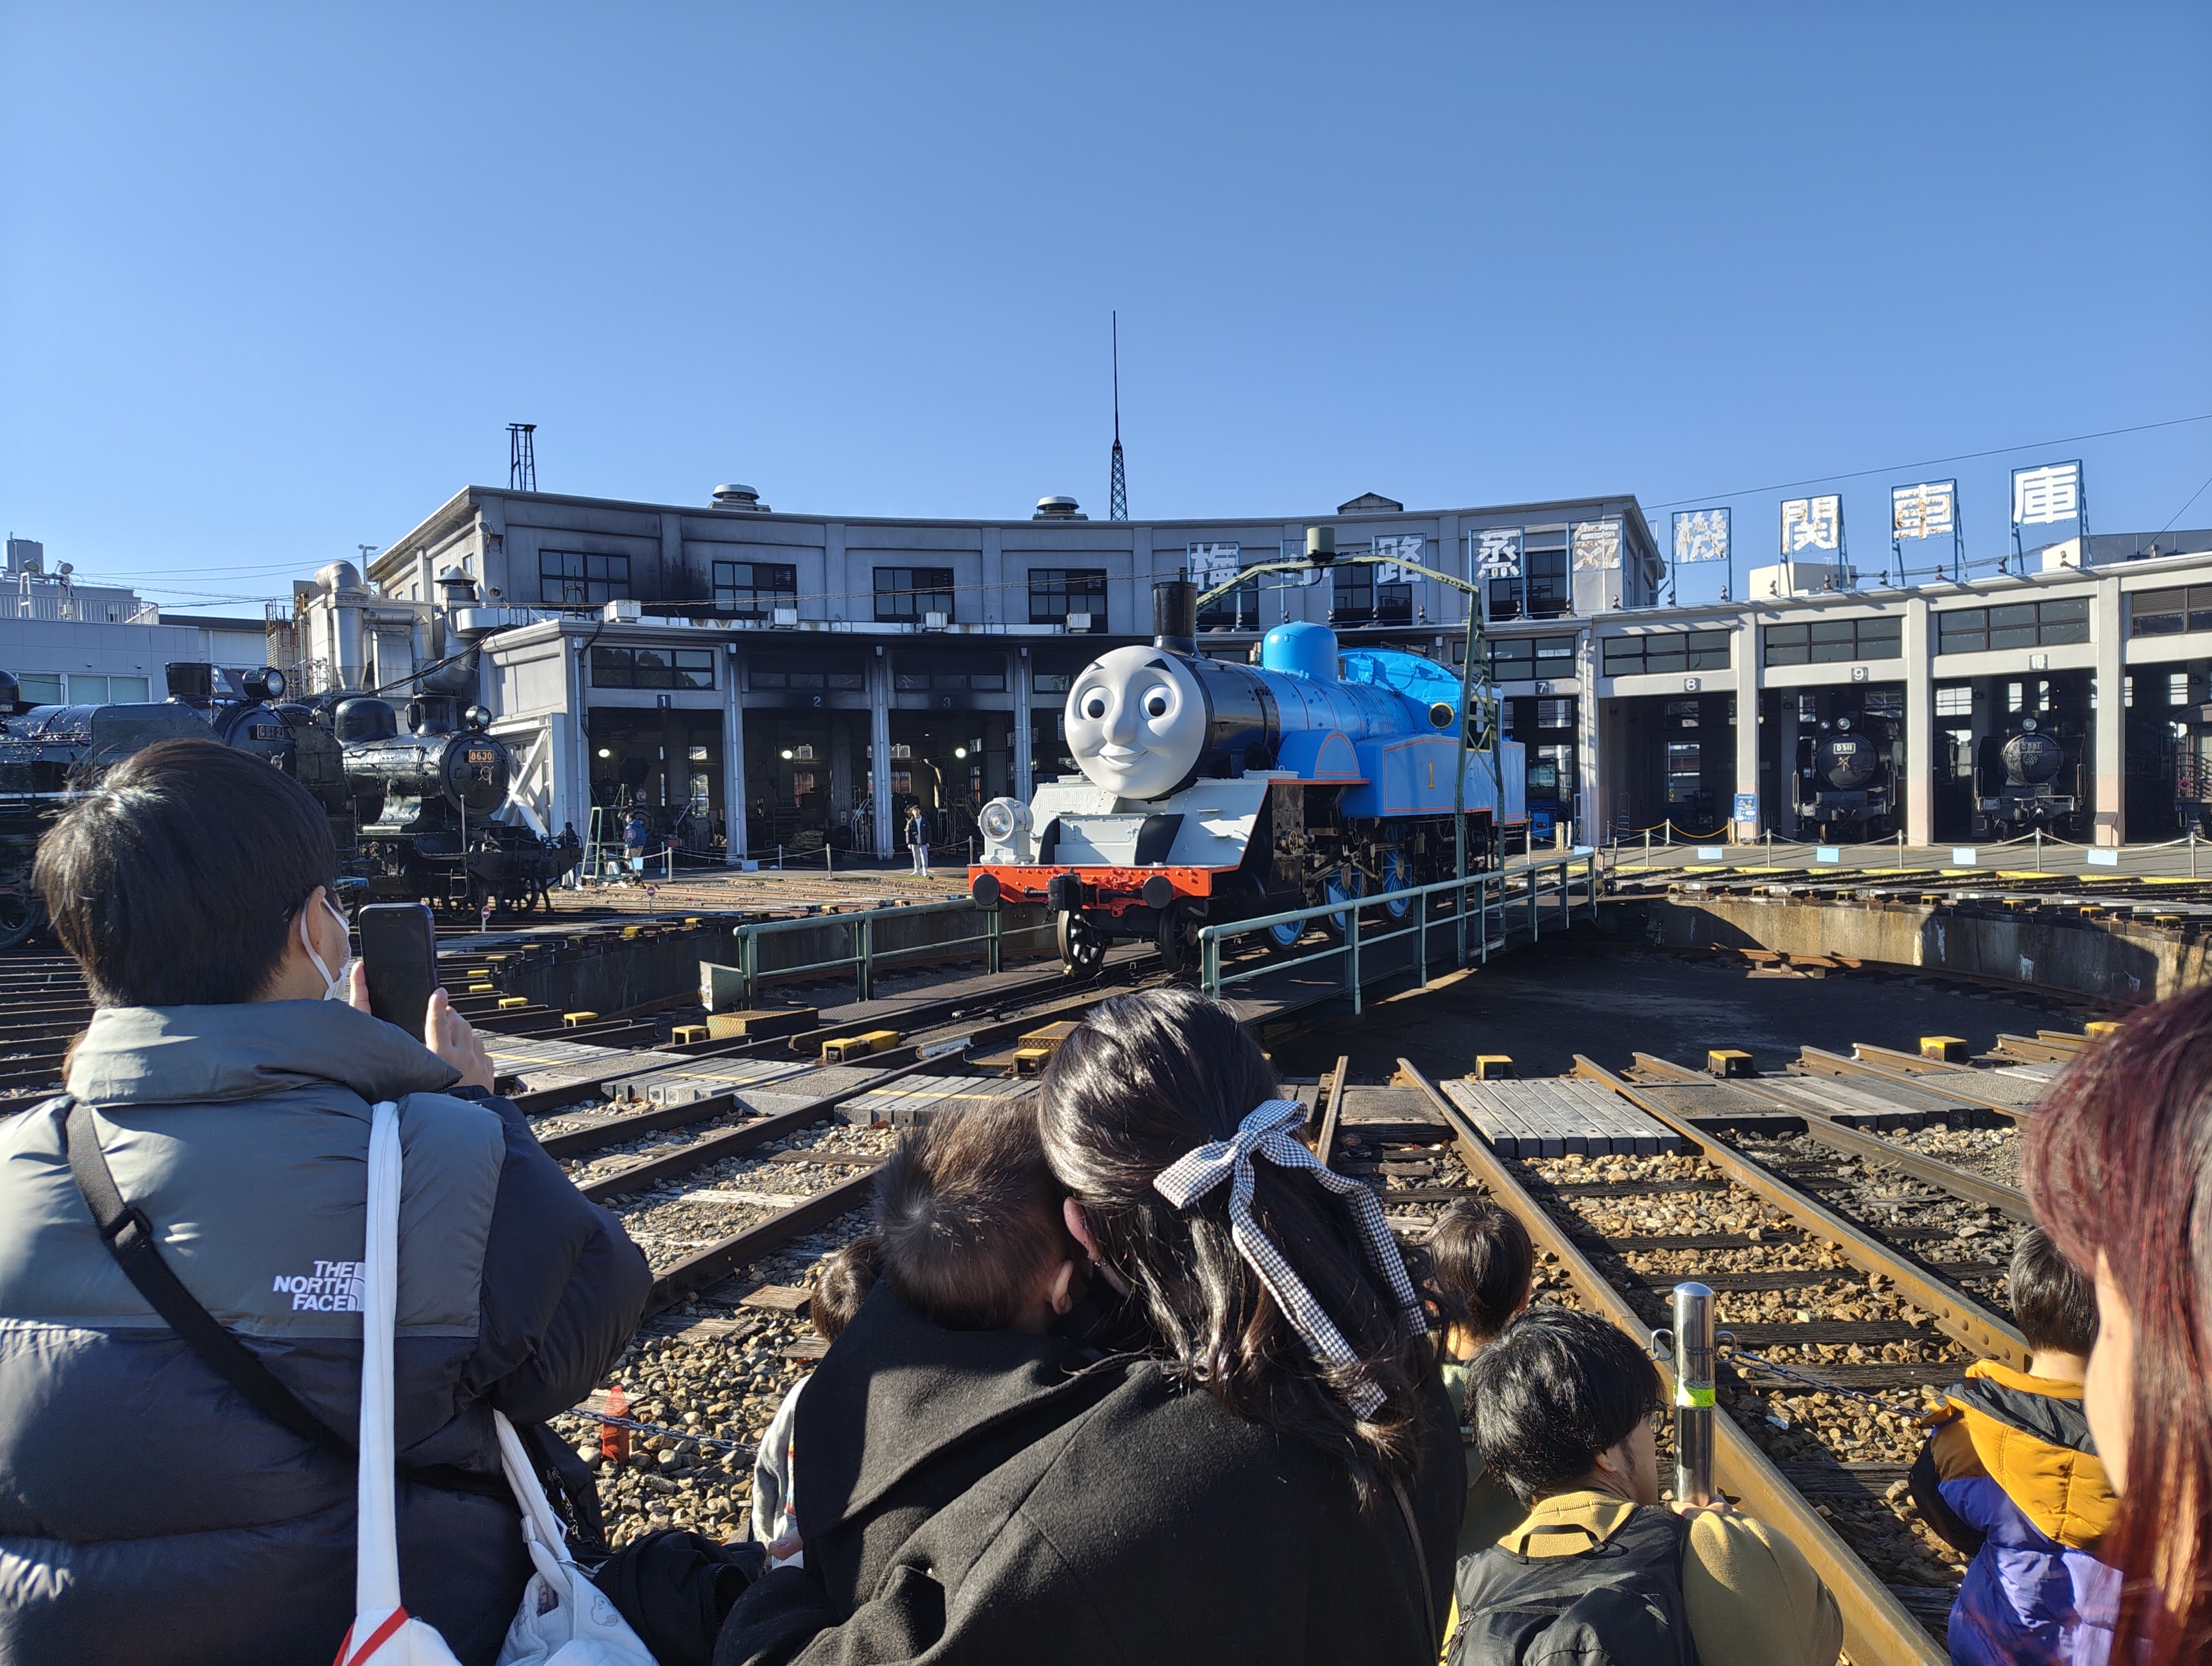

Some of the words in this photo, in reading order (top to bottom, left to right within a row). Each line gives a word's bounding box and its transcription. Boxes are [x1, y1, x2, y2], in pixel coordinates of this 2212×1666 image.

[1377, 536, 1423, 584] 路
[1473, 529, 1521, 580] 蒸
[1675, 509, 1728, 563] 機
[1782, 495, 1839, 554] 関
[1893, 483, 1953, 539] 車
[2013, 465, 2078, 524] 庫
[2031, 655, 2044, 669] 10
[1854, 668, 1864, 681] 9
[1538, 682, 1546, 694] 7
[1686, 679, 1696, 691] 8
[661, 695, 666, 707] 1
[813, 696, 821, 707] 2
[943, 697, 951, 707] 3
[471, 752, 492, 761] 8630
[1427, 760, 1435, 789] 1
[313, 1260, 355, 1278] THE
[273, 1276, 351, 1294] NORTH
[292, 1294, 348, 1311] FACE
